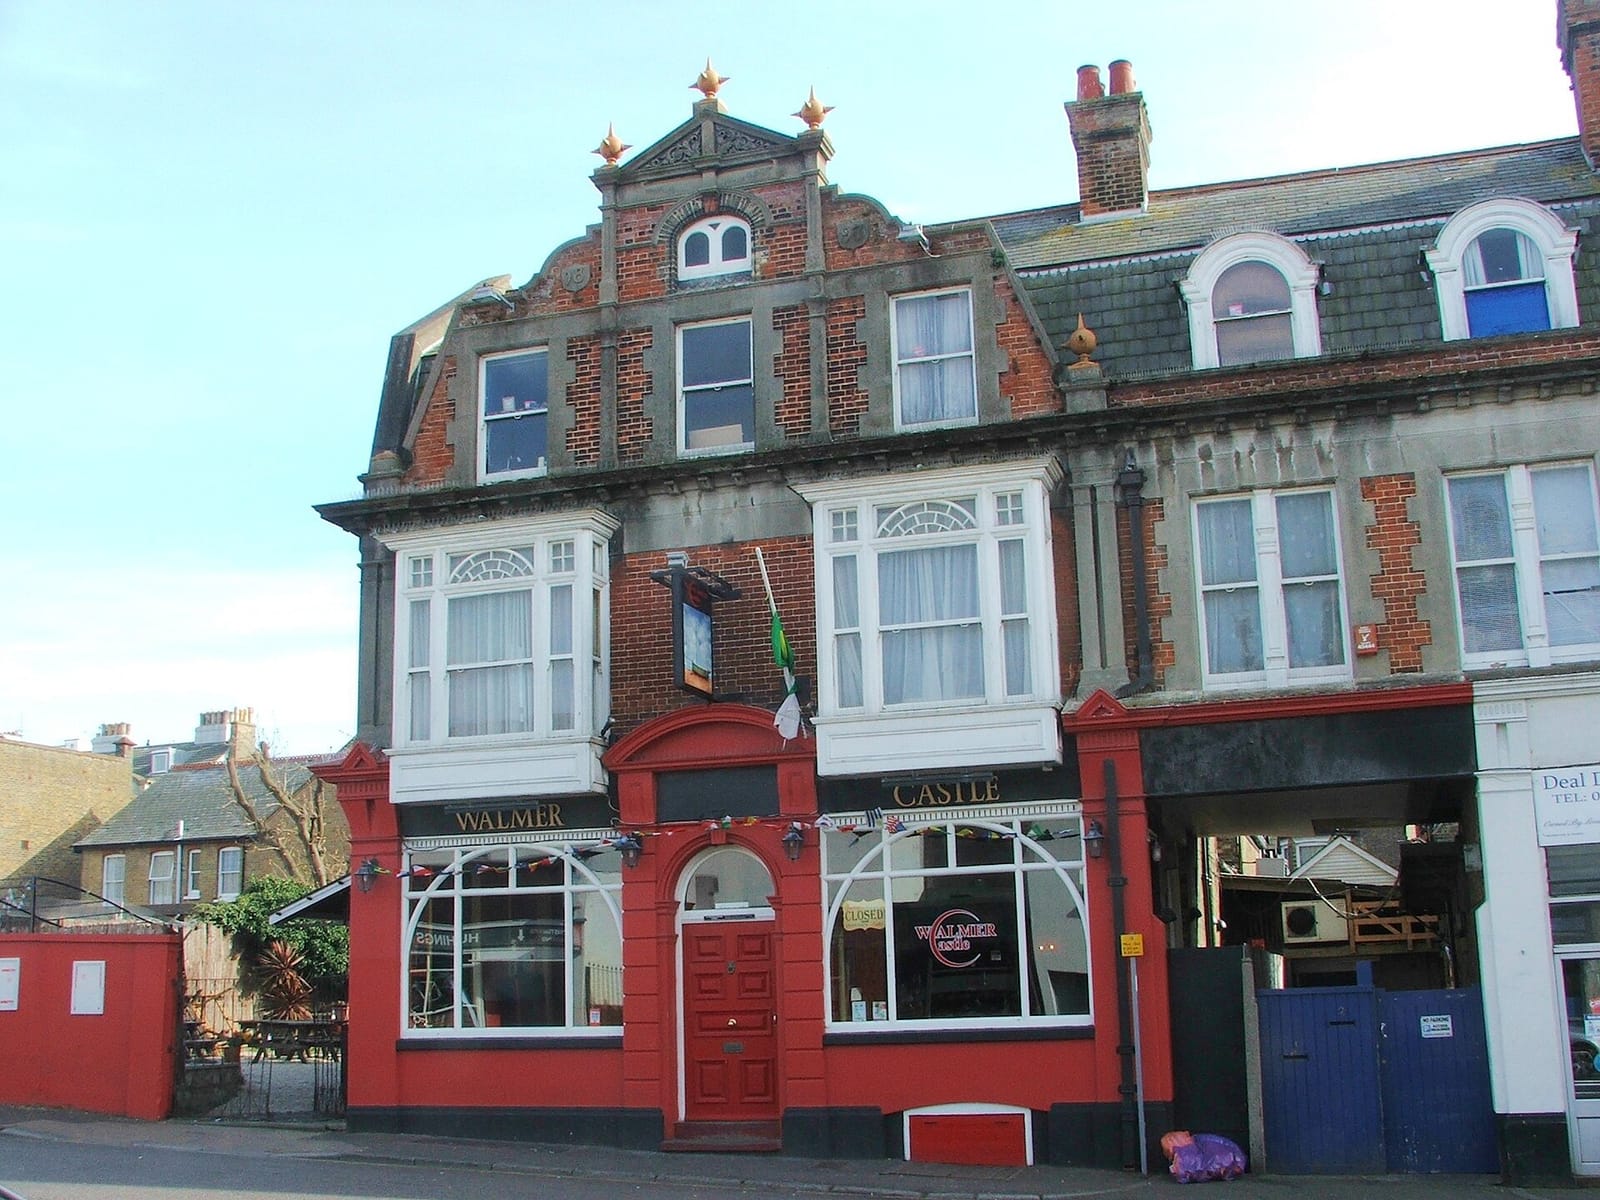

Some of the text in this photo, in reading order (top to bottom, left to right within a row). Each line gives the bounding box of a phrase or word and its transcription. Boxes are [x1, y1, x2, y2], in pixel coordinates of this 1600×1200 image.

[1543, 772, 1586, 789] Deal
[893, 775, 1000, 807] CASTLE
[1552, 792, 1588, 804] TEL:
[456, 803, 566, 831] WALMER
[845, 909, 884, 921] CLOSED
[914, 923, 997, 939] WALMER
